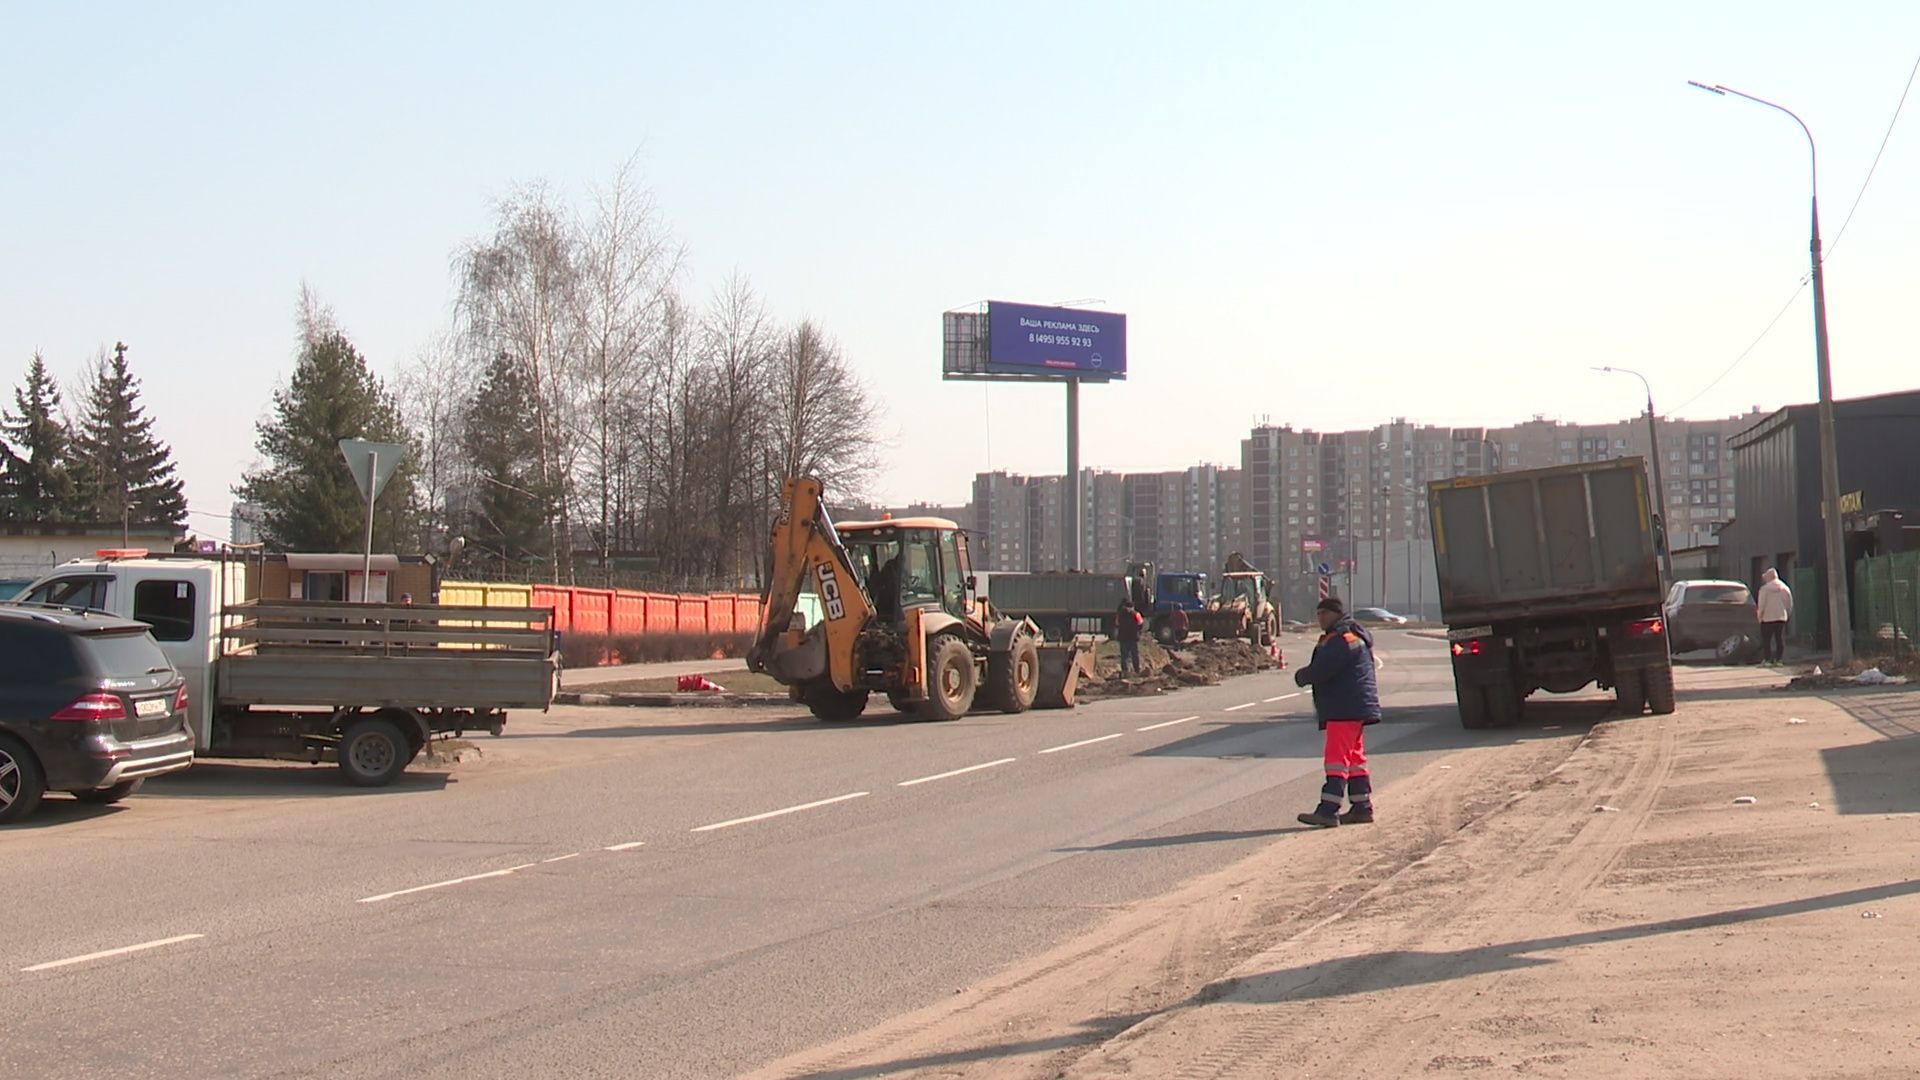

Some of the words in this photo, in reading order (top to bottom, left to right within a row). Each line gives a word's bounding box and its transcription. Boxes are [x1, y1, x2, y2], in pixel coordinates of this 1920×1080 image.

[1020, 317, 1042, 328] ВАША
[1043, 320, 1077, 331] РЕКЛАМА
[1078, 324, 1100, 333] ЗДЕСЬ
[1028, 332, 1035, 343] 8
[1035, 333, 1055, 345] (495)
[1055, 335, 1070, 346] 955
[1071, 336, 1081, 346] 92
[1082, 337, 1092, 348] 93
[817, 562, 844, 620] JCB
